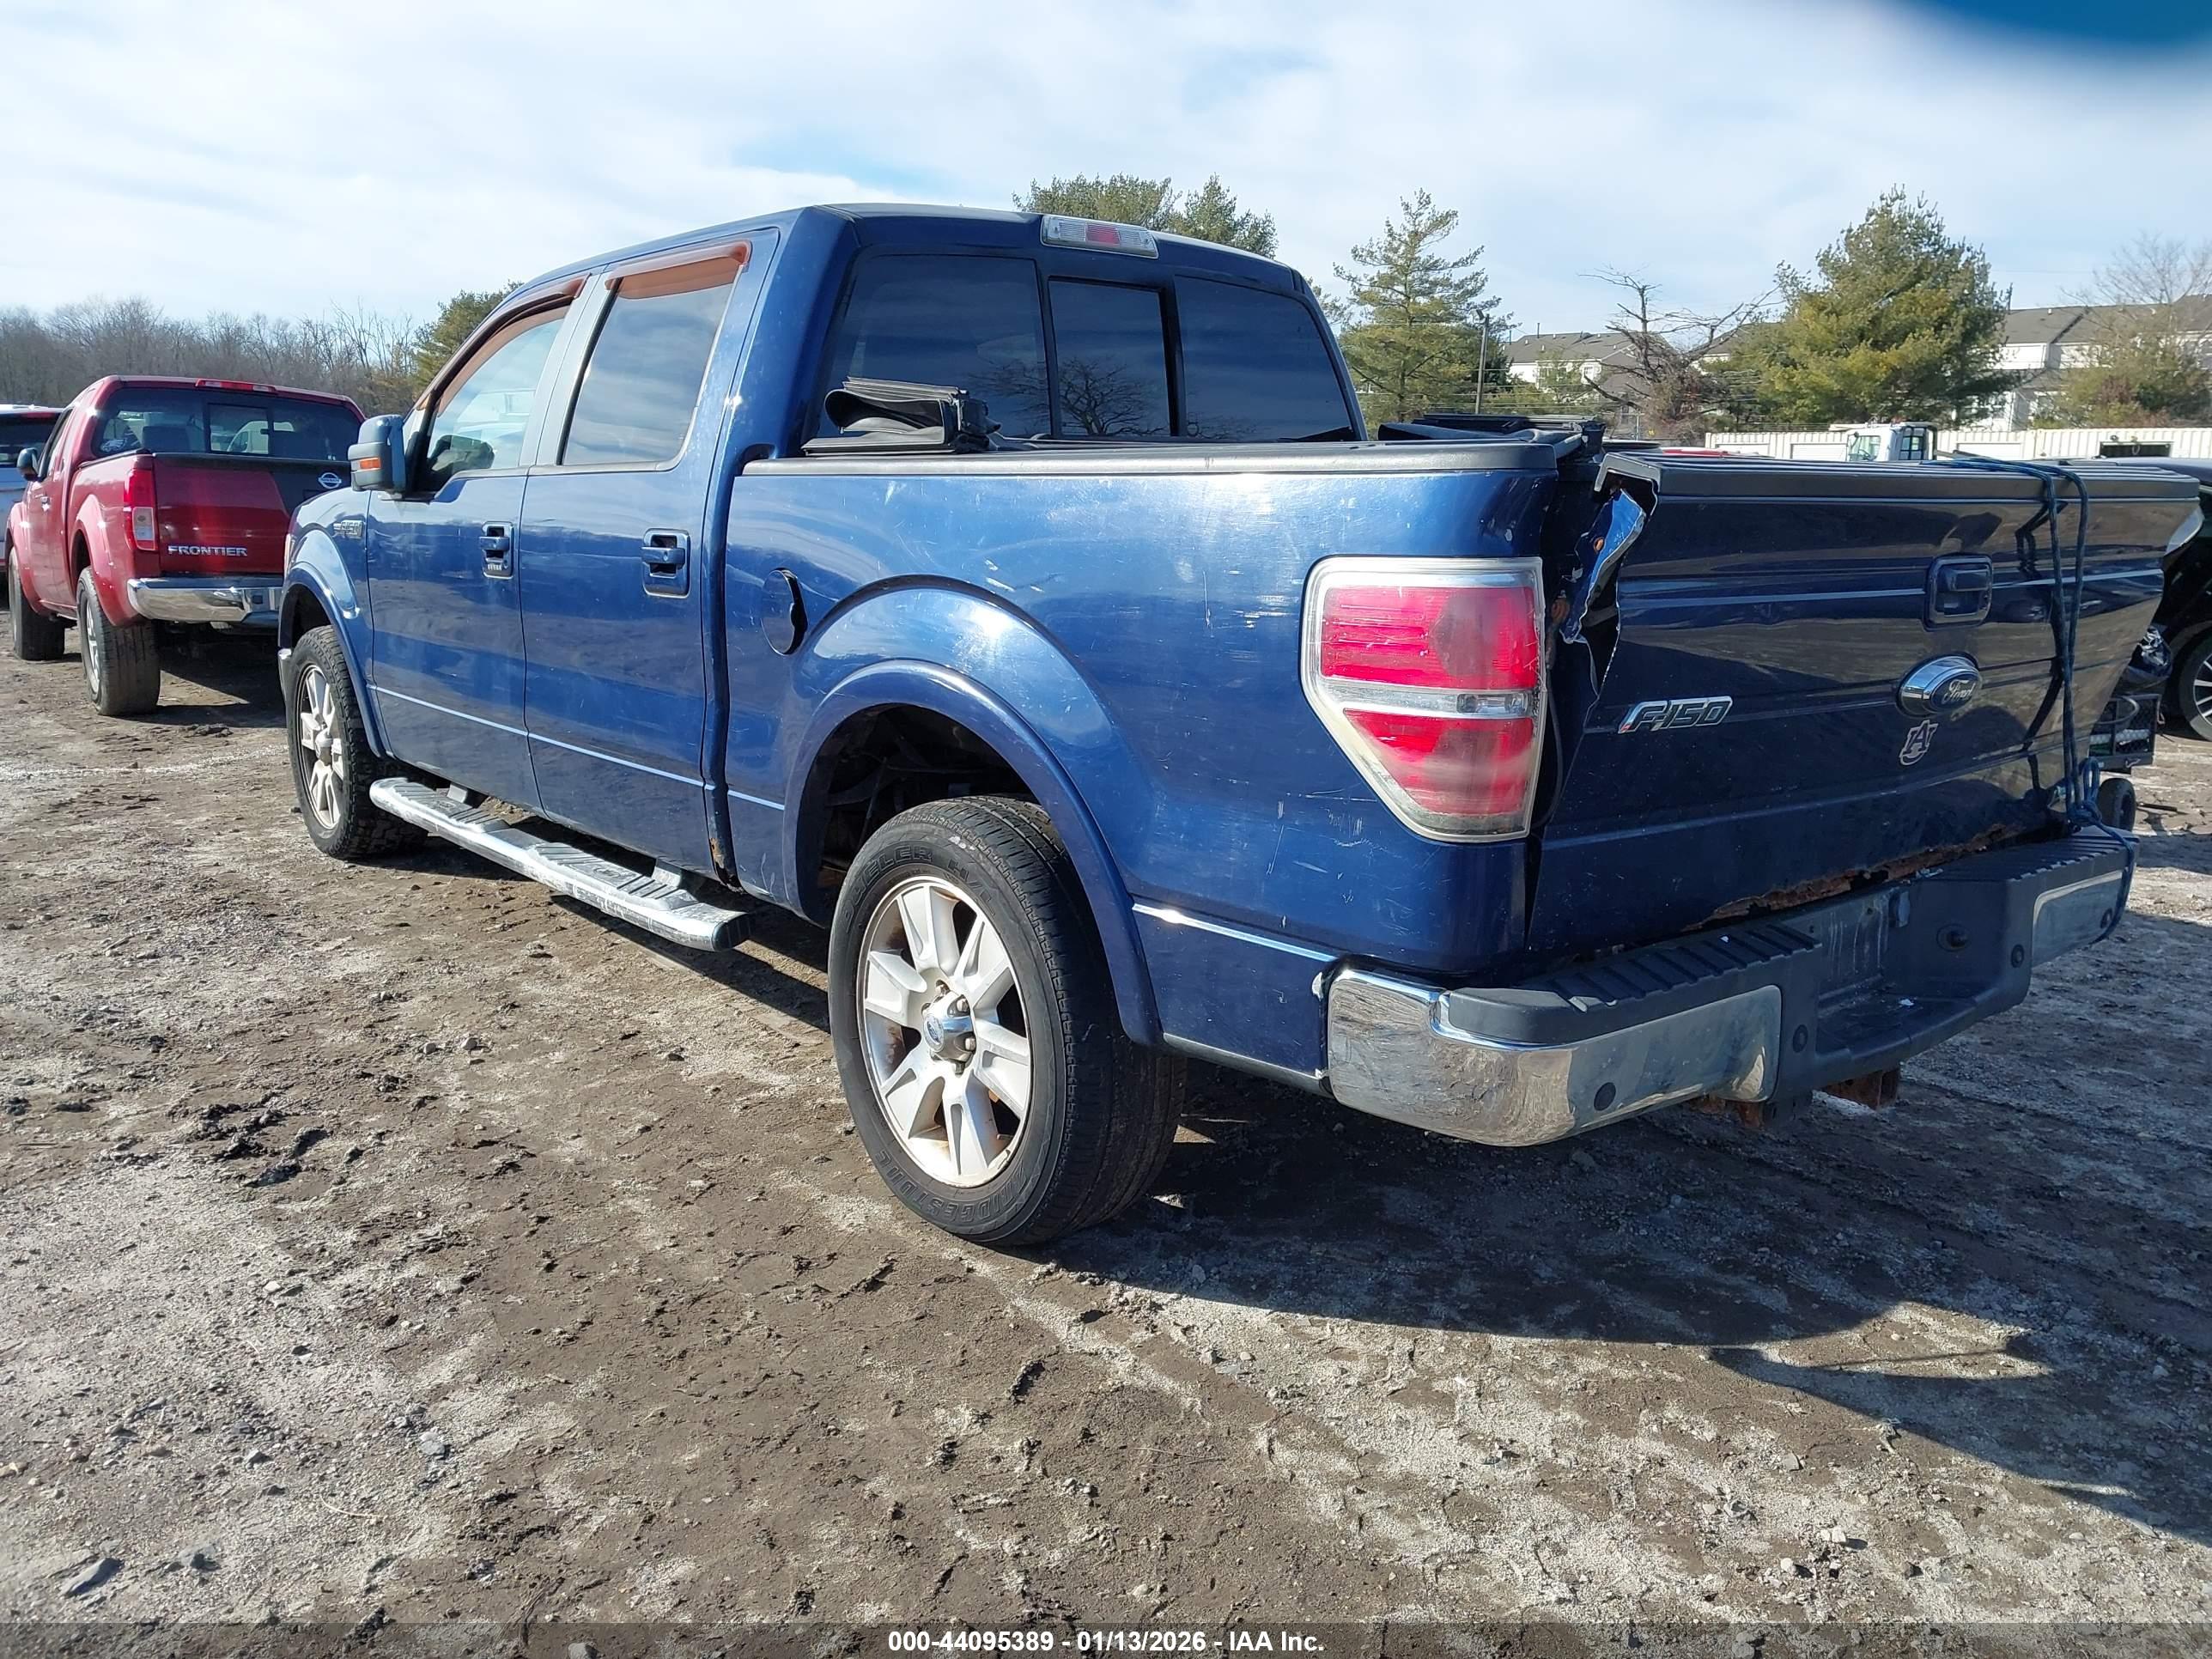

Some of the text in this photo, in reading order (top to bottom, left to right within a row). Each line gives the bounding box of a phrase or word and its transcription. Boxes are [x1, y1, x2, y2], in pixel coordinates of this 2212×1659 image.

[167, 545, 248, 556] FRONTIER
[1942, 678, 1977, 704] Ford
[843, 845, 933, 933] DUELER
